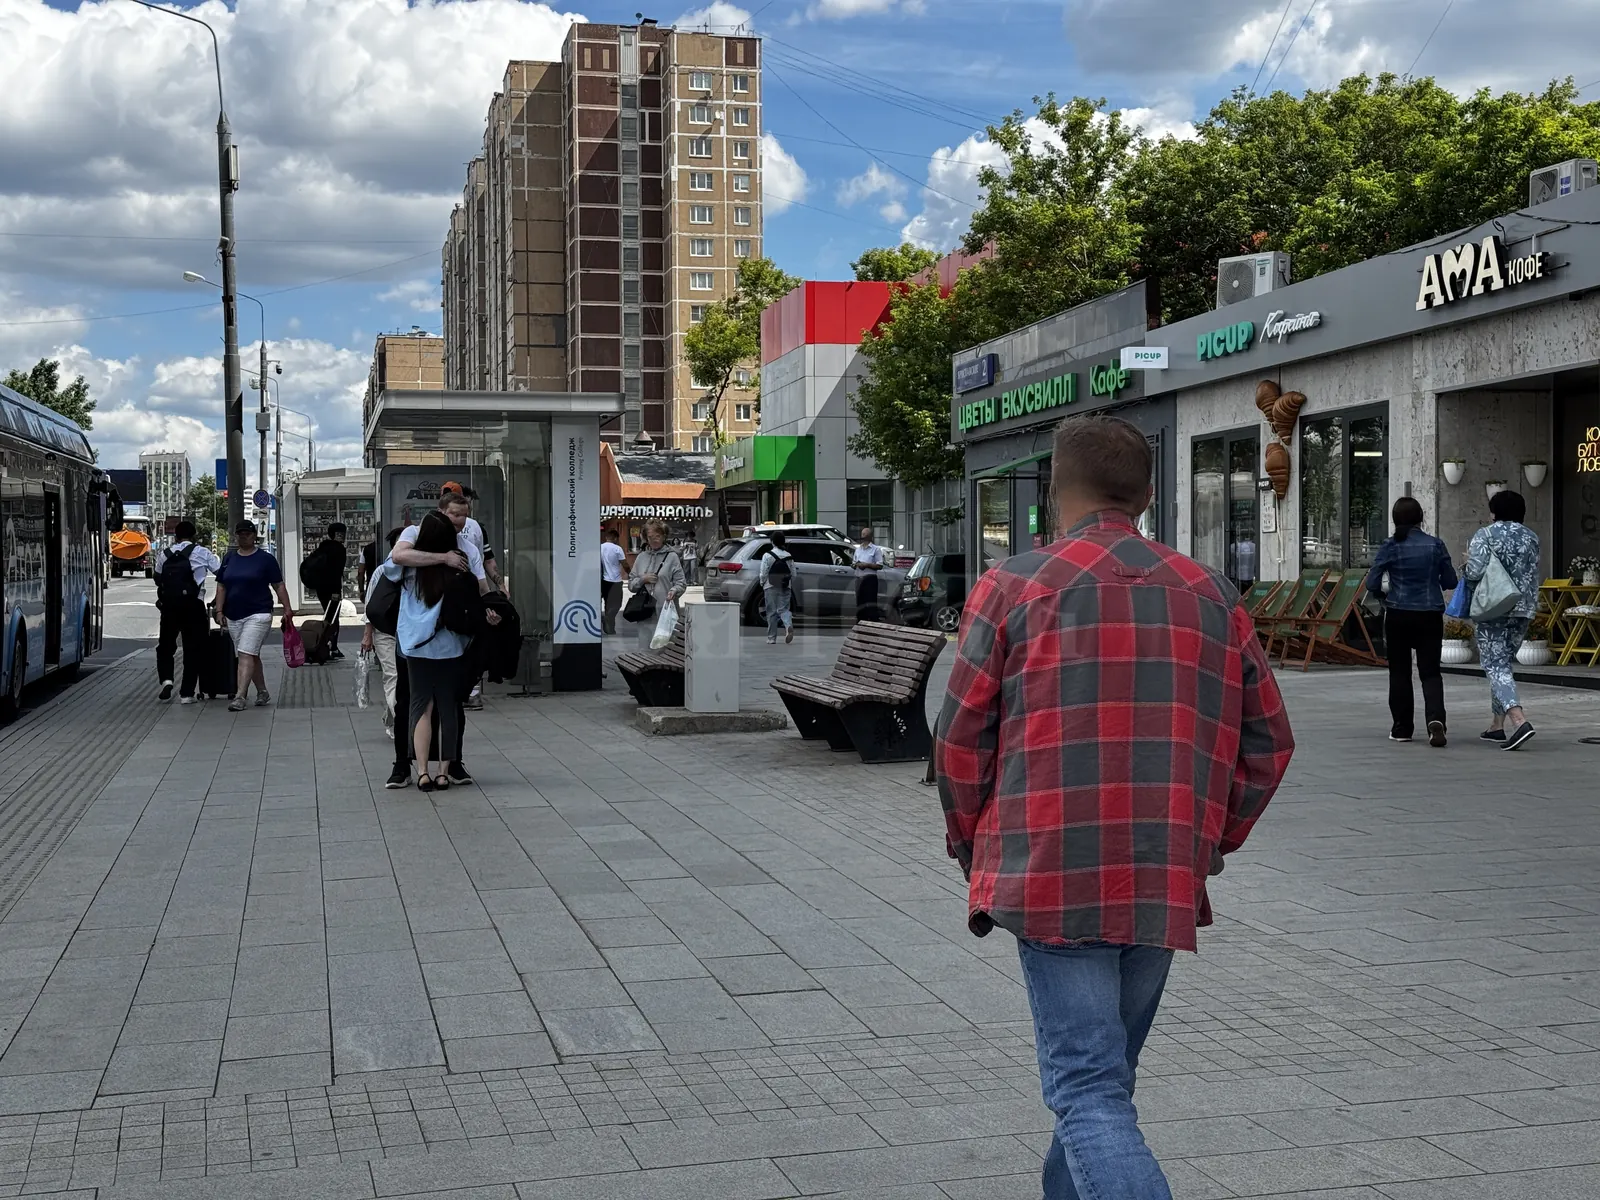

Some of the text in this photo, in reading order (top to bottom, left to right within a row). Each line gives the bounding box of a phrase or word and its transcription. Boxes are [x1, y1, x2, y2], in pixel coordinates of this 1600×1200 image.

[1416, 235, 1543, 311] АМА КОФЕ
[1134, 352, 1162, 360] PICUP
[1196, 321, 1254, 361] PICUP
[1089, 358, 1127, 400] Кафе
[958, 372, 1073, 433] ЦВЕТЫ ВКУСВИЛЛ
[568, 437, 577, 558] Полиграфический колледж
[656, 505, 714, 518] ХАЛЯЛЬ
